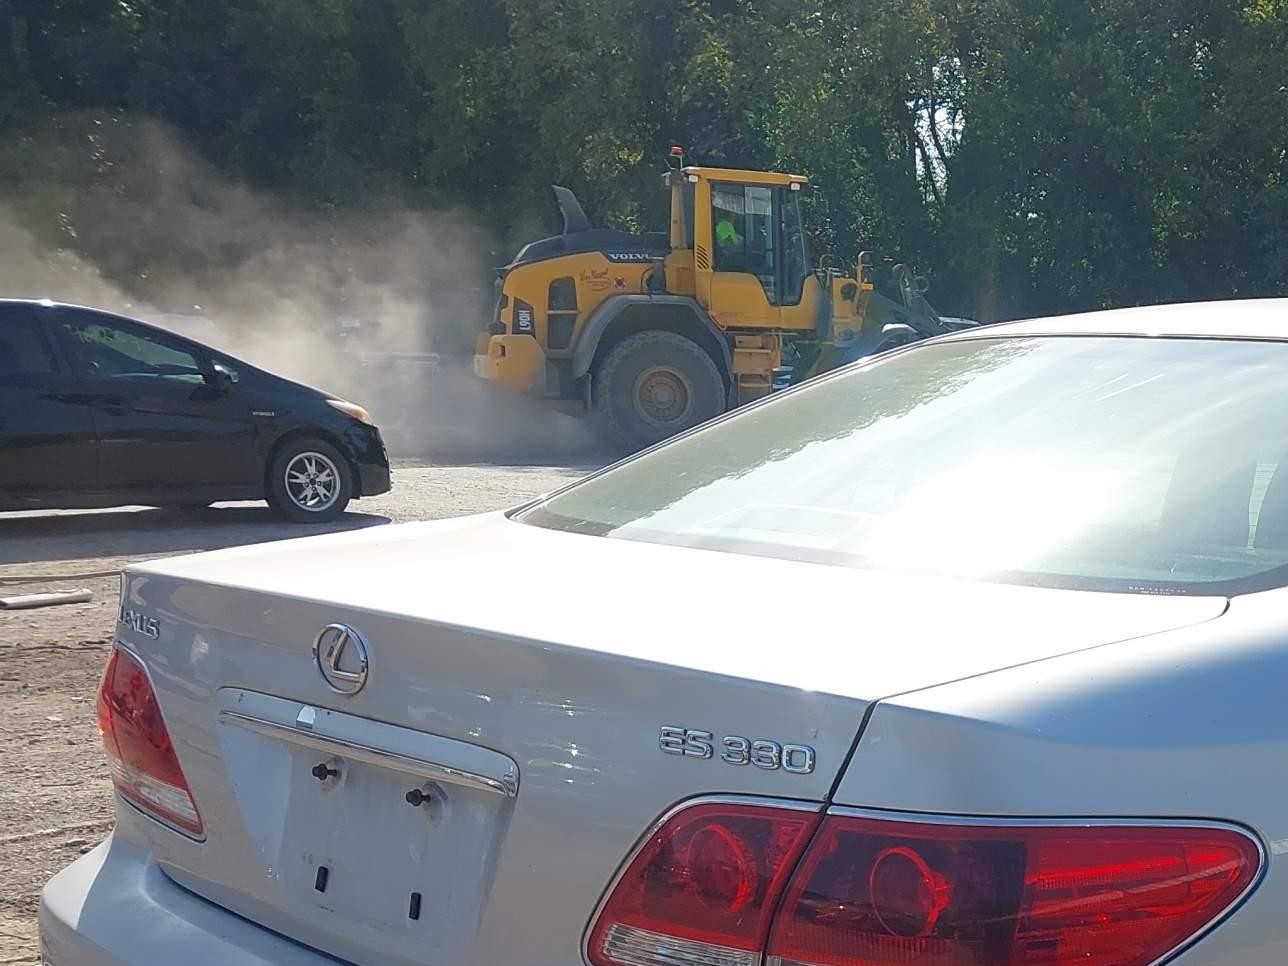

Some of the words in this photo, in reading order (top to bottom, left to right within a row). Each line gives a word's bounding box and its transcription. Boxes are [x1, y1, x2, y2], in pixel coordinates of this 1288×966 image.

[518, 310, 531, 330] L90H
[659, 725, 714, 760] ES
[720, 735, 816, 775] 330
